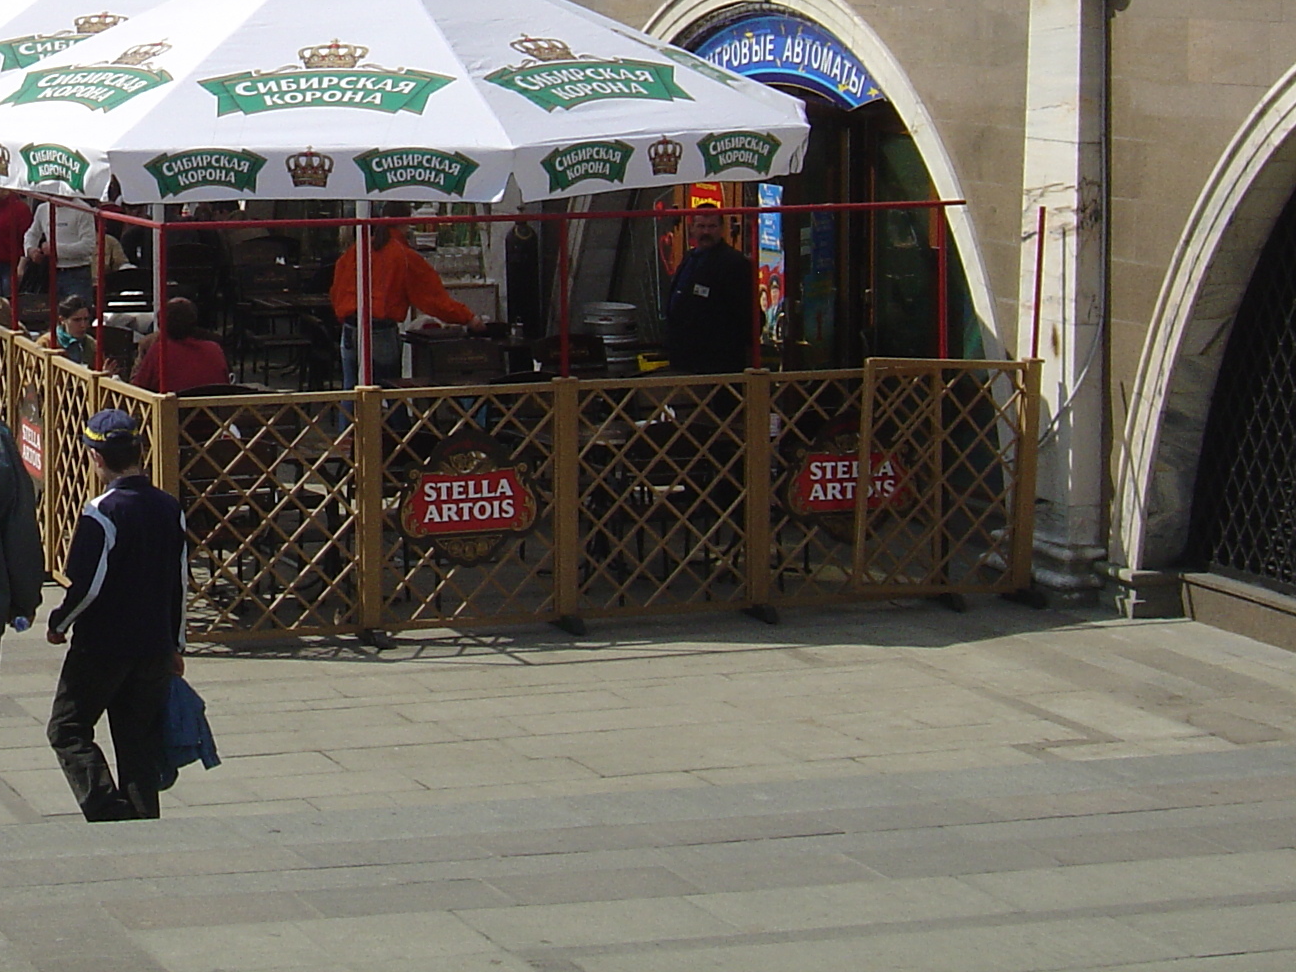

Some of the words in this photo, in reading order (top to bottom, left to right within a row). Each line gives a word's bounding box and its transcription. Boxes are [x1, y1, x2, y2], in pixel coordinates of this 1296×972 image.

[782, 34, 866, 98] АВТОМАТЫ
[37, 71, 148, 93] СИБИРСКАЯ
[234, 75, 418, 98] СИБИРСКАЯ
[514, 67, 655, 91] СИБИРСКАЯ
[37, 85, 116, 103] КОРОНА
[264, 89, 384, 106] КОРОНА
[551, 81, 649, 101] КОРОНА
[709, 136, 770, 156] СИБИРСКАЯ
[29, 149, 81, 174] СИБИРСКАЯ
[162, 154, 250, 178] СИБИРСКАЯ
[371, 152, 461, 177] СИБИРСКАЯ
[555, 147, 622, 171] СИБИРСКАЯ
[718, 150, 759, 166] КОРОНА
[38, 165, 73, 182] КОРОНА
[177, 169, 236, 186] КОРОНА
[386, 168, 446, 186] КОРОНА
[566, 162, 610, 180] КОРОНА
[22, 423, 41, 451] STELLA
[424, 478, 514, 502] STELLA
[423, 499, 515, 523] ARTOIS
